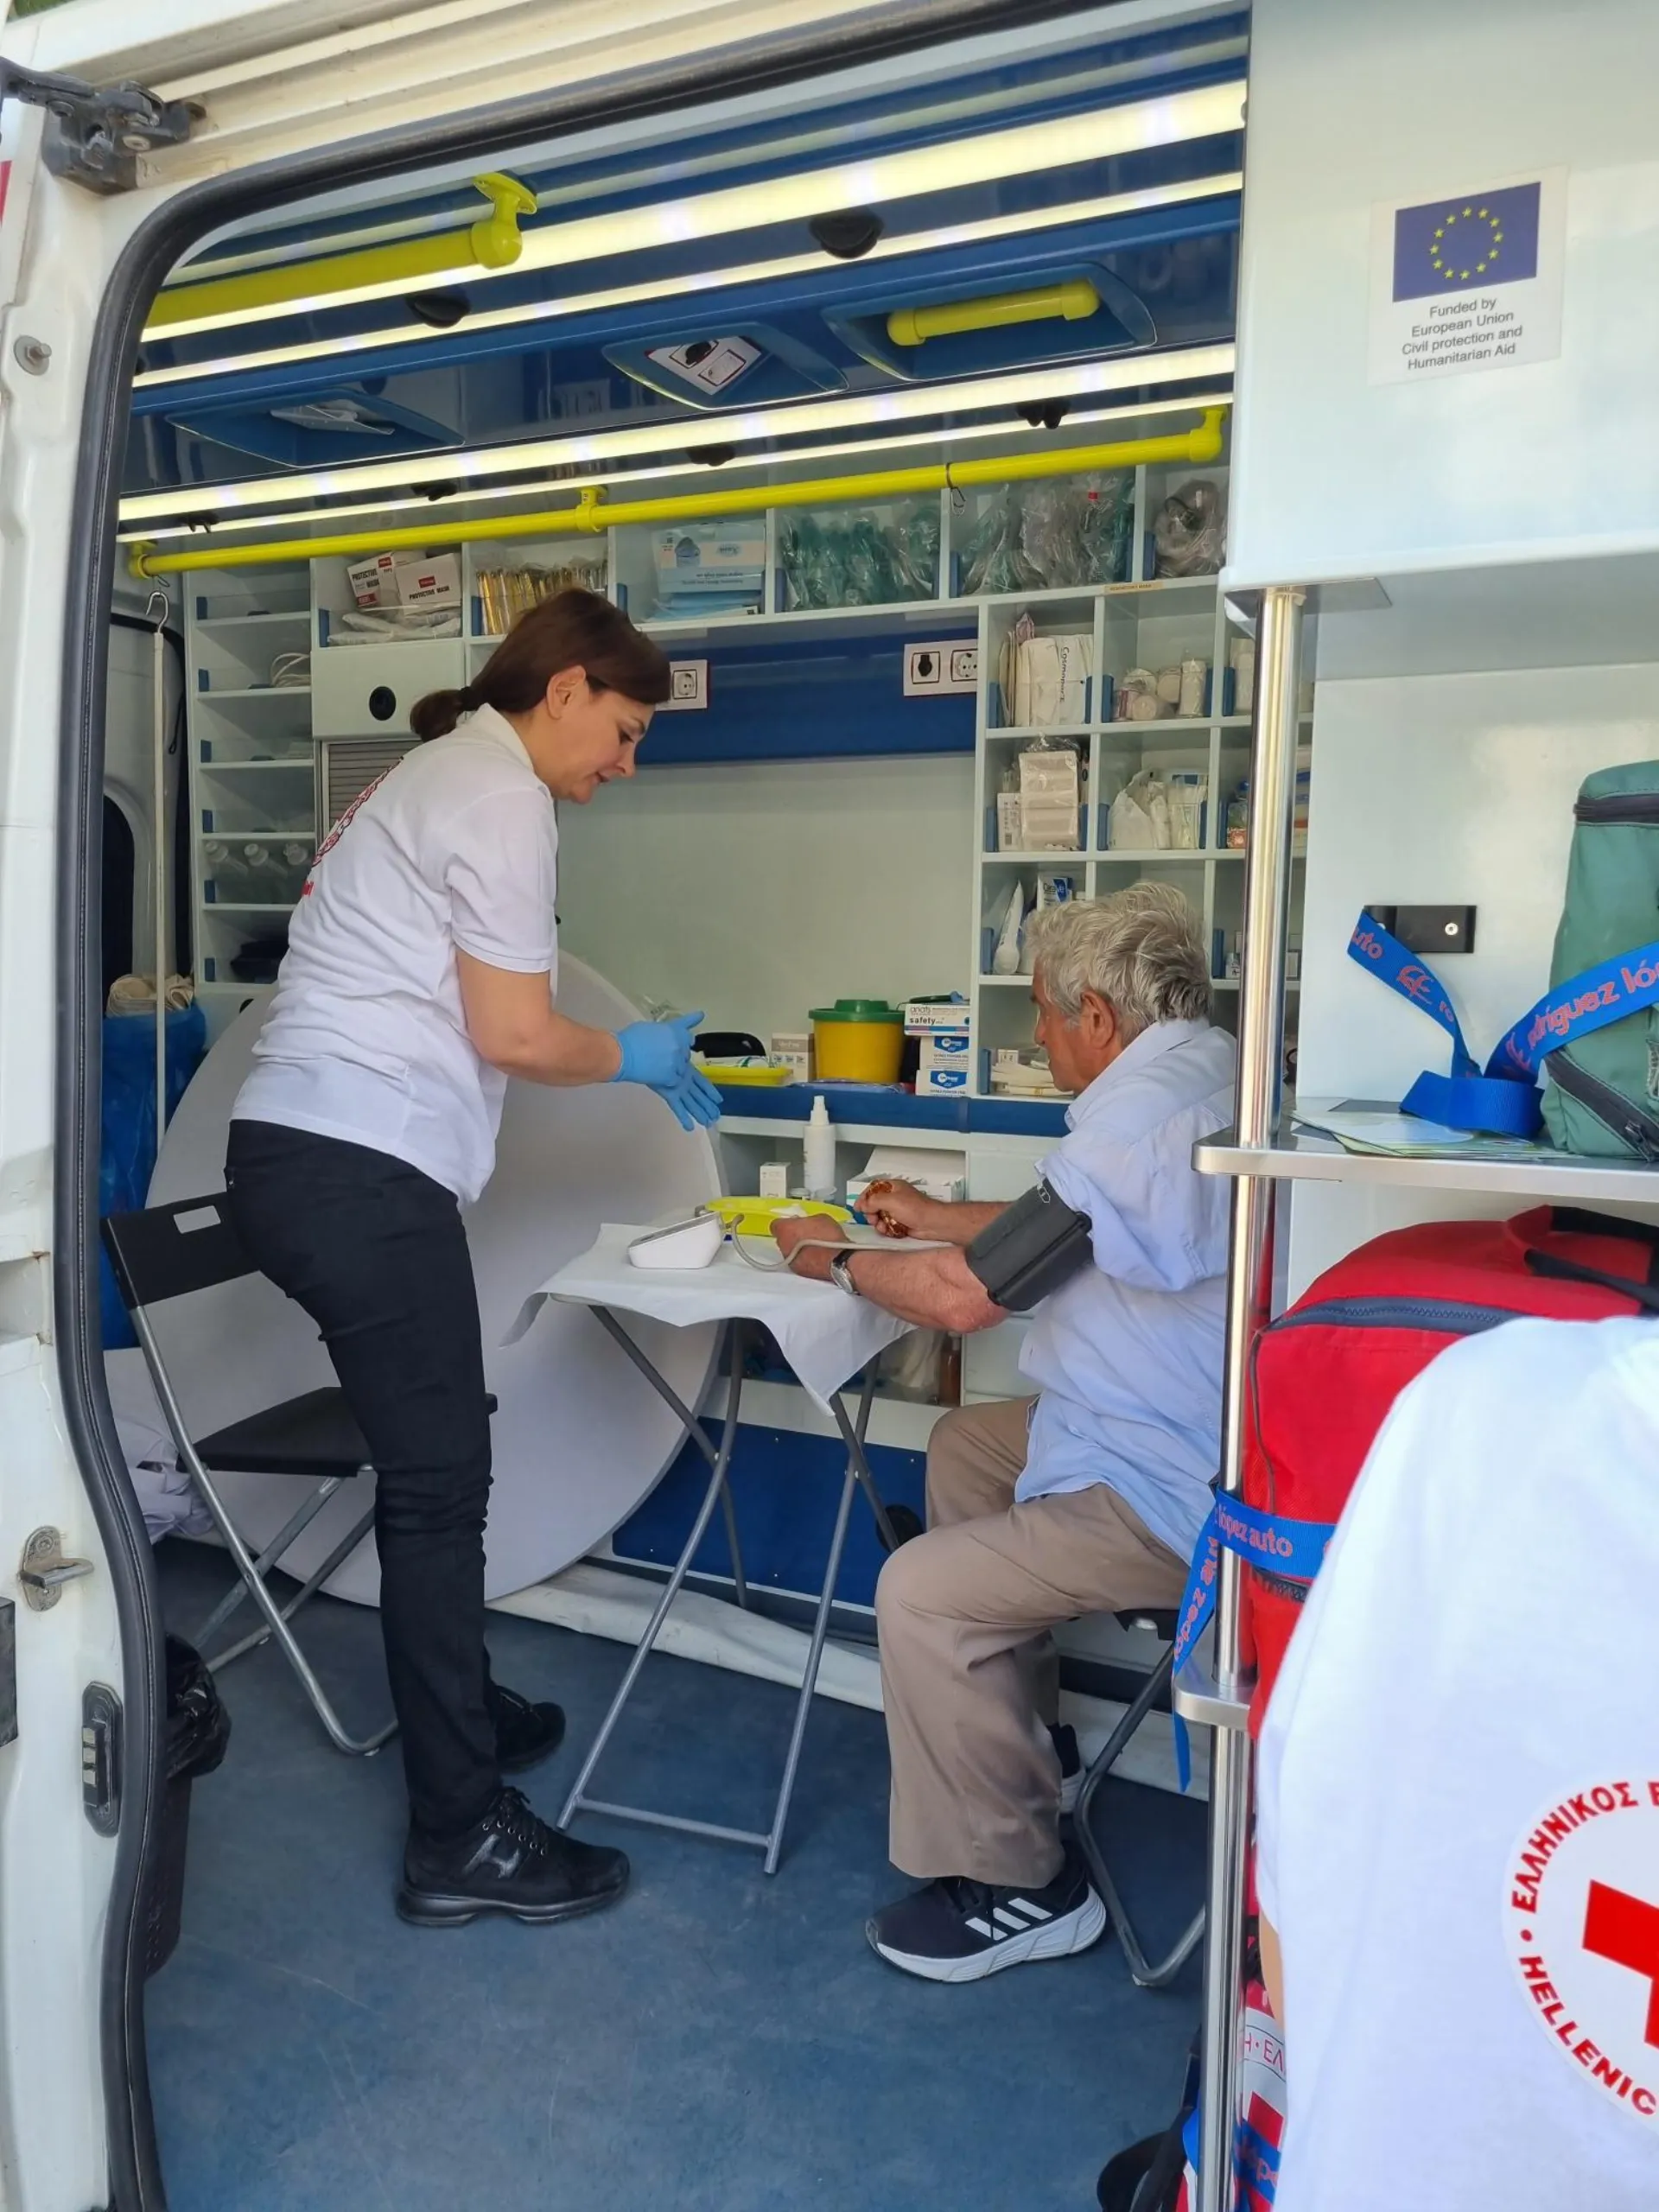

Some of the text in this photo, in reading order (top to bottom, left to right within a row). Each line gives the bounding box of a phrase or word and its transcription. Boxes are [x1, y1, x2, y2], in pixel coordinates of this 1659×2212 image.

[1429, 297, 1497, 318] Funded by
[1411, 311, 1514, 338] European Union
[1402, 325, 1522, 355] Civil protection and
[1408, 343, 1516, 370] Humanitarian Aid
[910, 1017, 936, 1026] safety
[1249, 1527, 1293, 1557] auto
[1511, 1781, 1639, 1914] ΕΛΛΗΝΙΚΟΣ
[1519, 1955, 1656, 2115] HELLENIC
